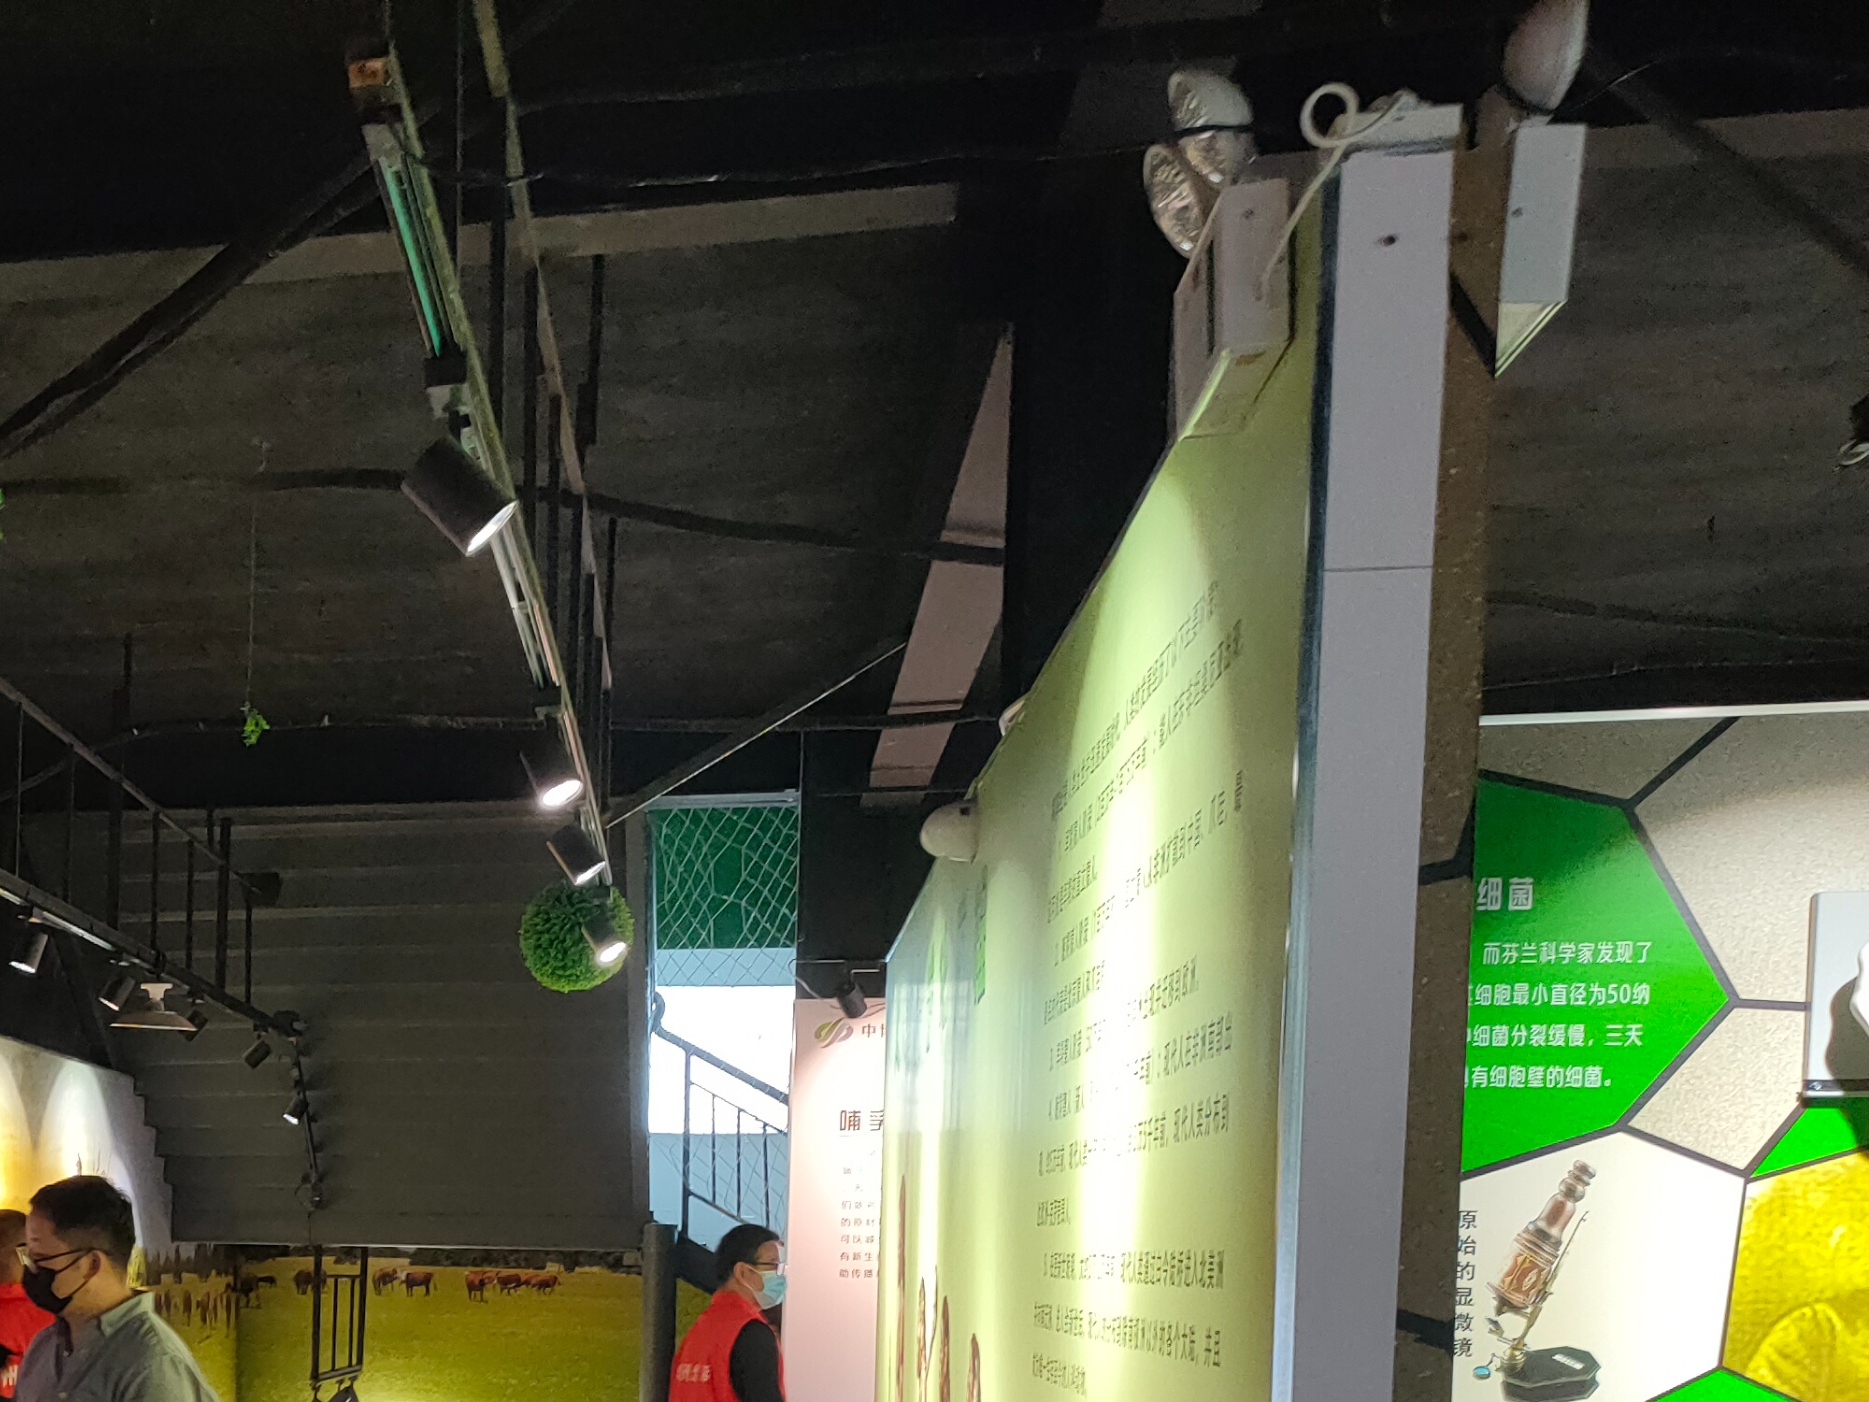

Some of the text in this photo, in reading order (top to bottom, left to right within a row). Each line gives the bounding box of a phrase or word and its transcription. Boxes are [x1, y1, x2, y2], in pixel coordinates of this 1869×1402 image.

[1476, 876, 1534, 912] 细菌
[1482, 941, 1653, 965] 而芬兰科学家发现了
[1468, 982, 1651, 1008] 细胞最小直径为50纳
[1466, 1022, 1644, 1048] 细菌分裂缓慢，三天
[1464, 1065, 1612, 1090] 有细胞壁的细菌。
